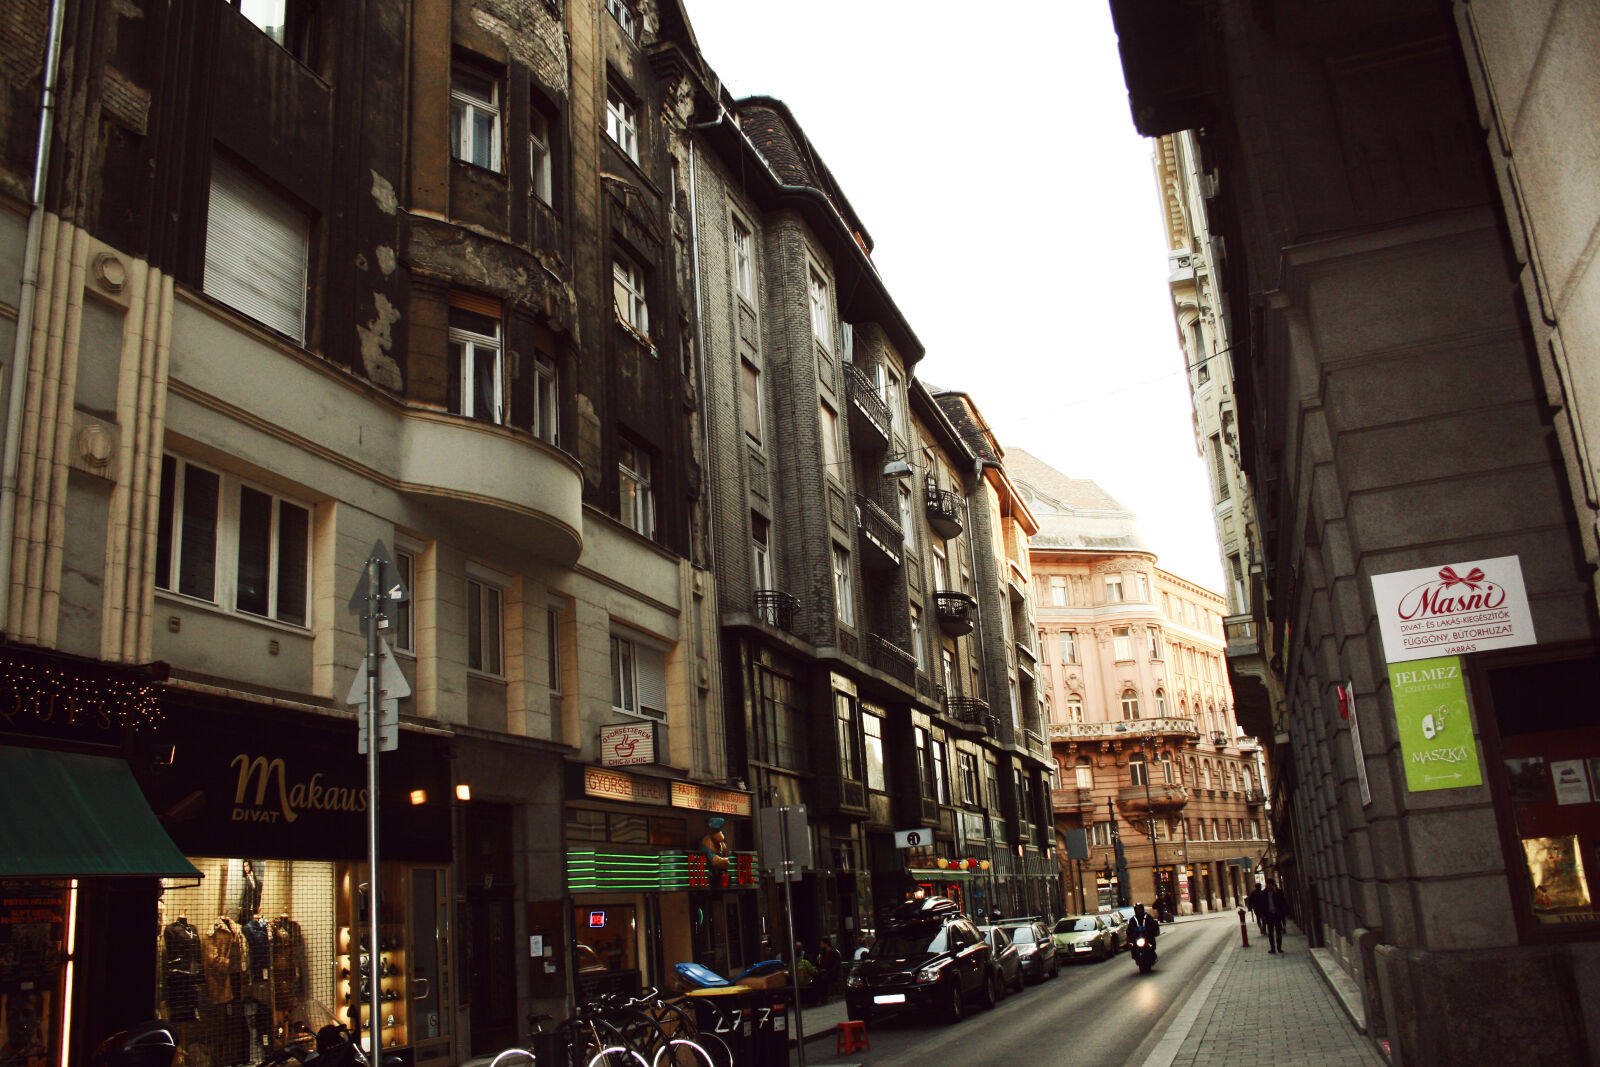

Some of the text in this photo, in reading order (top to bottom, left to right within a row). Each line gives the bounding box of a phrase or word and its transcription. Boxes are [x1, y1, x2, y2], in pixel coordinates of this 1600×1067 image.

[1398, 583, 1506, 620] Masni
[1400, 621, 1425, 633] DIVAT-
[1426, 620, 1435, 629] ÉS
[1444, 643, 1477, 655] VARRÁS
[1395, 666, 1459, 688] JELMEZ
[1411, 746, 1468, 765] MASZKA
[687, 797, 707, 810] LUNCH
[231, 807, 280, 823] DIVAT
[757, 1007, 771, 1030] 7
